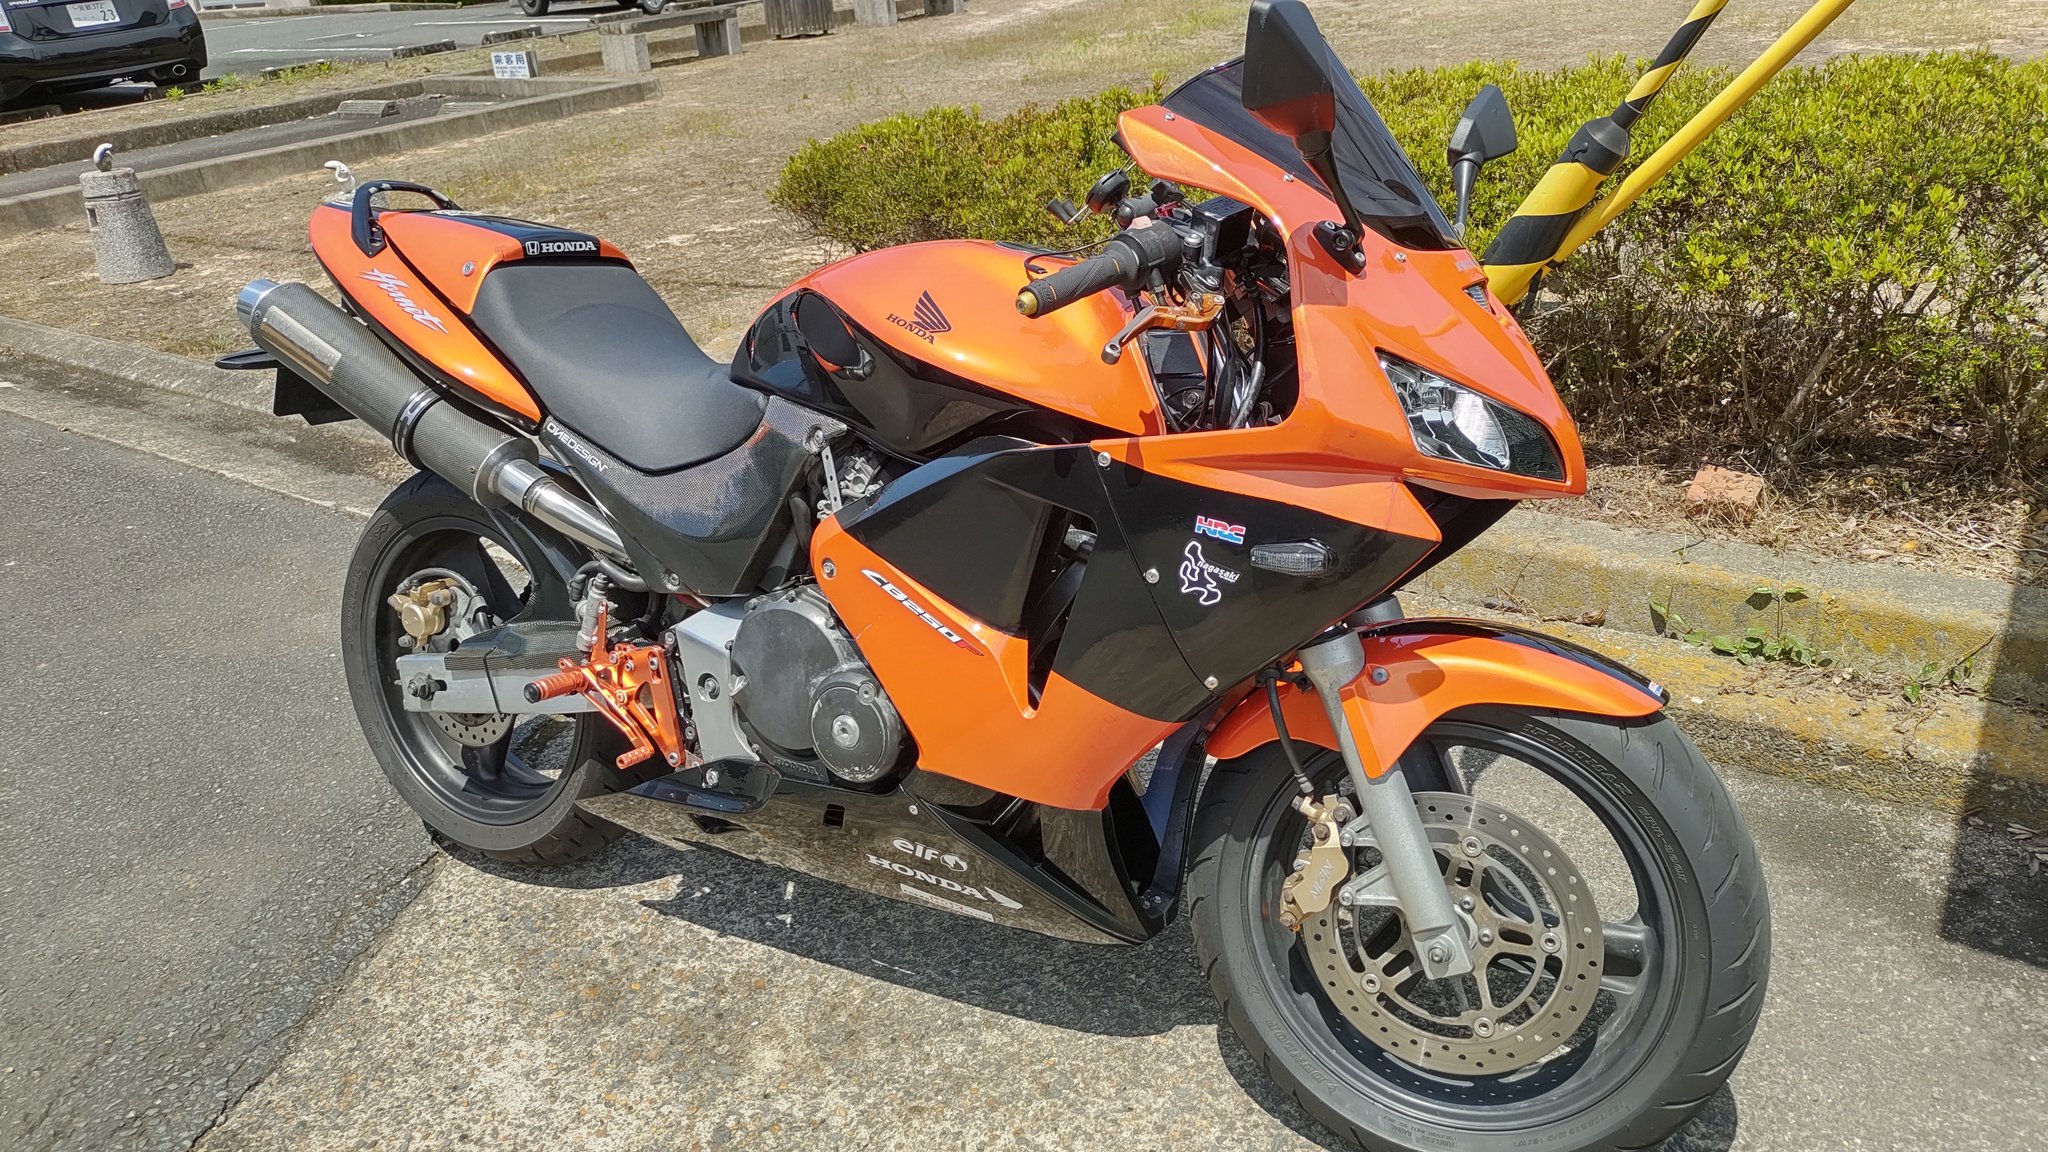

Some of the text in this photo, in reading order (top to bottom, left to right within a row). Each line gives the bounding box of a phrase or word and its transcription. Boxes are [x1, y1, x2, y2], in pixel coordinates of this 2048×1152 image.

[494, 54, 525, 65] 来客用
[541, 241, 597, 253] HONDA
[356, 267, 450, 335] Hornet
[885, 313, 936, 345] HONDA
[546, 422, 609, 473] ONEDESIGN
[1194, 515, 1246, 545] HRC
[1197, 560, 1240, 581] nagasaki
[892, 838, 941, 862] elf
[865, 853, 989, 901] HONDA
[1265, 1020, 1326, 1085] DUNLOP
